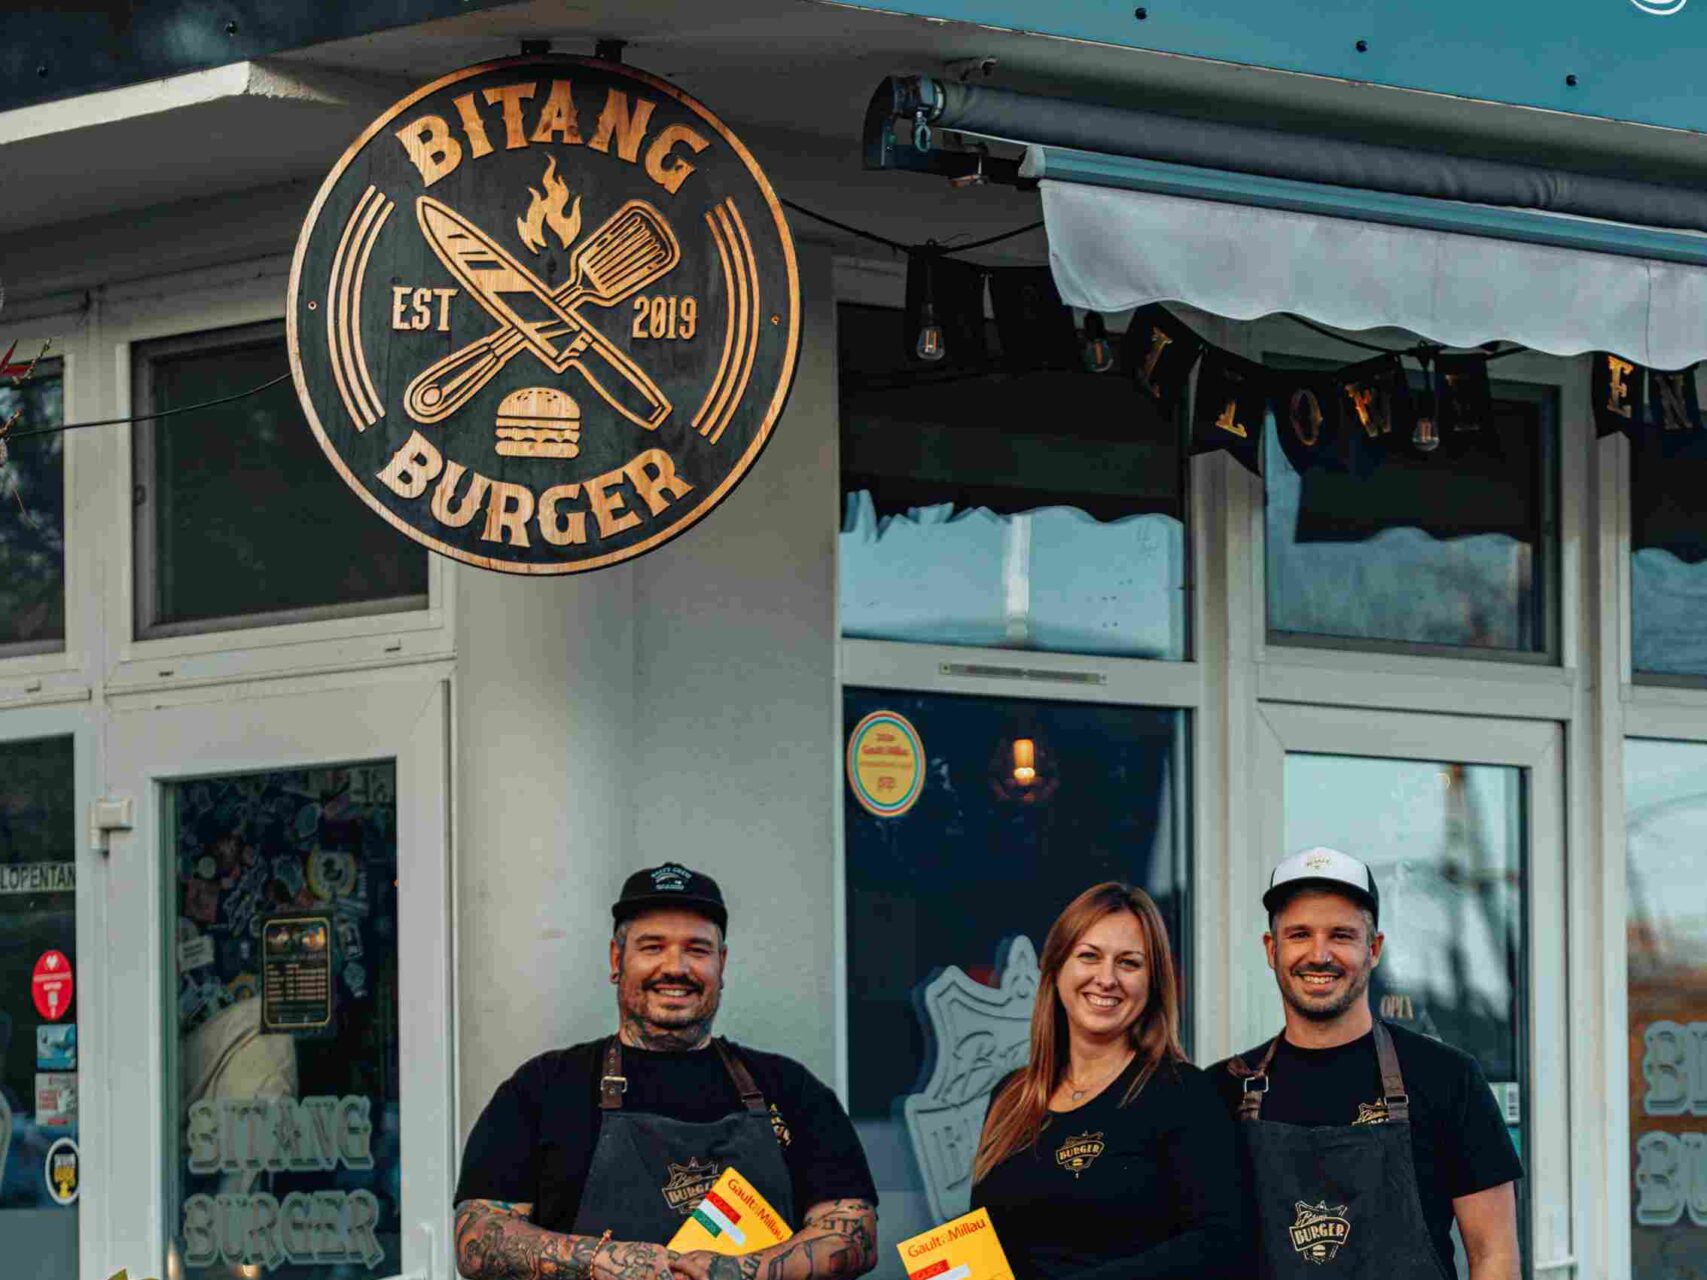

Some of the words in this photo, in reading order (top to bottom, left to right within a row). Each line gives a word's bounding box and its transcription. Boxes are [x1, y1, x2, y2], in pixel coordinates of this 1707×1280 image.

[396, 79, 710, 194] BITANG
[391, 286, 459, 332] EST
[632, 295, 698, 341] 2019
[376, 429, 696, 549] BURGER
[1294, 1222, 1346, 1245] BURGER
